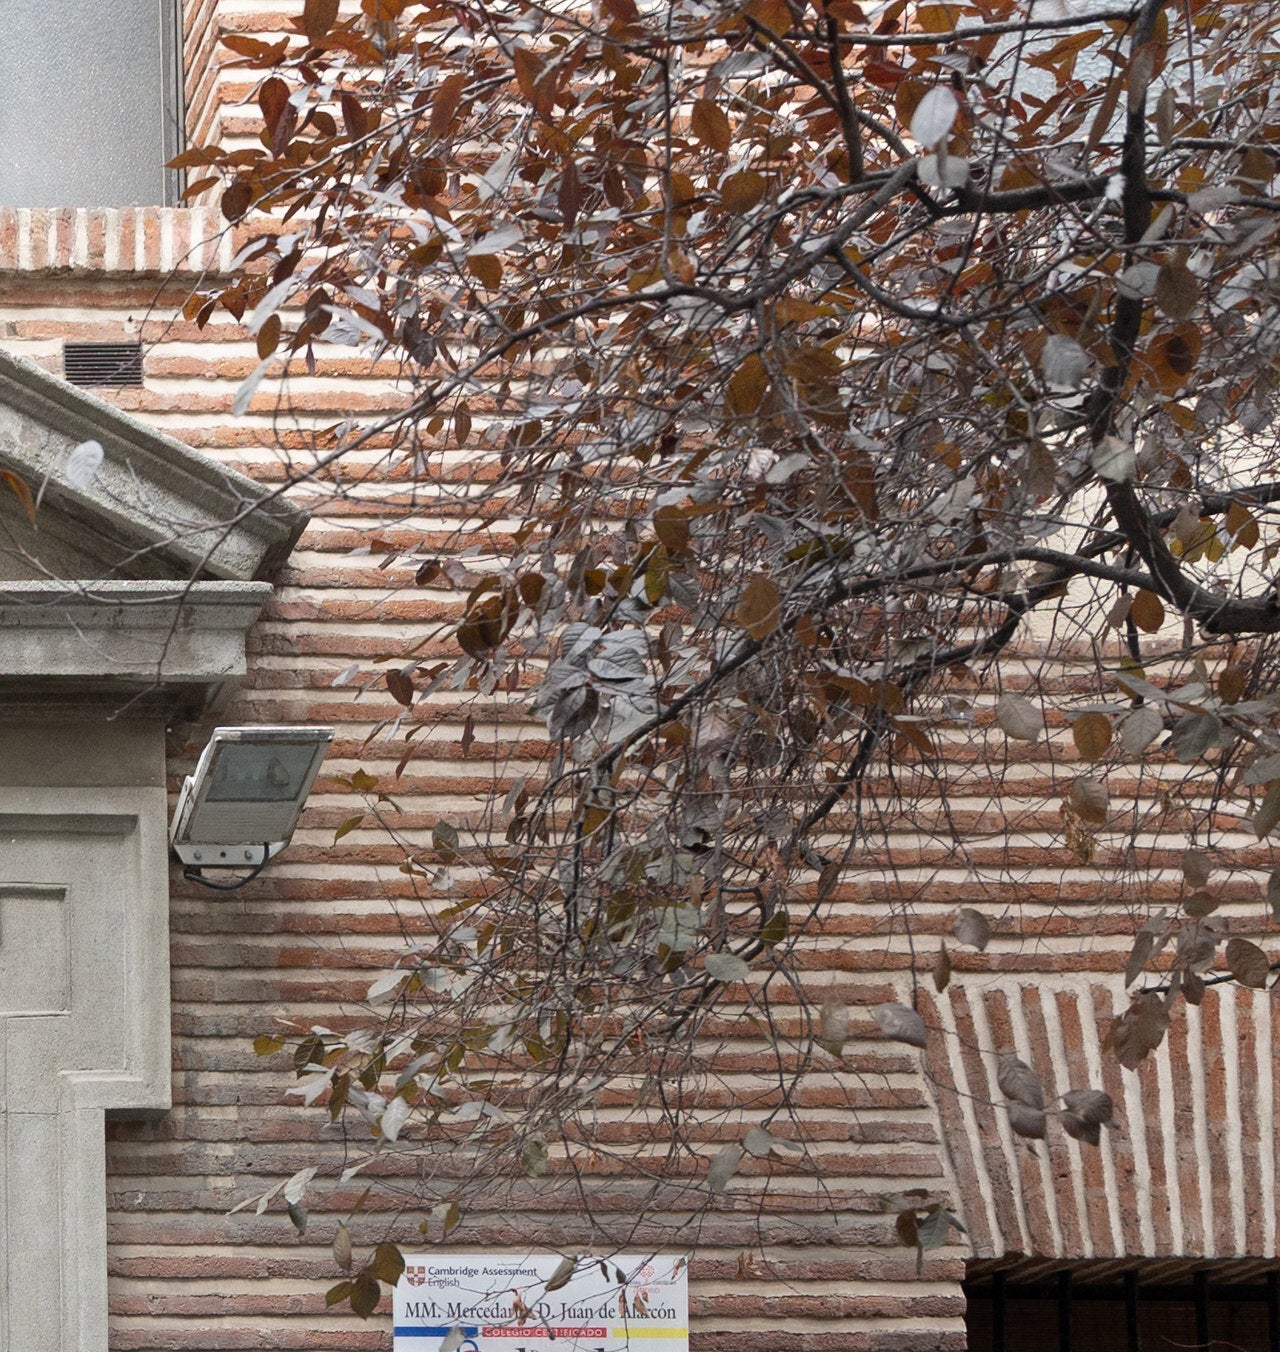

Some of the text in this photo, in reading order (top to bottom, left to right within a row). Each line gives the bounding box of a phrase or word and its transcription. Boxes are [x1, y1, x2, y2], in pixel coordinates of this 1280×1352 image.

[428, 1266, 537, 1277] Cambridge Assessment
[428, 1277, 460, 1289] English
[405, 1302, 441, 1318] MM.
[447, 1302, 535, 1319] Mercedar
[538, 1302, 555, 1319] D.
[560, 1302, 594, 1322] Juan
[599, 1302, 615, 1319] de
[485, 1328, 603, 1337] COLEGIO CETIFICADO
